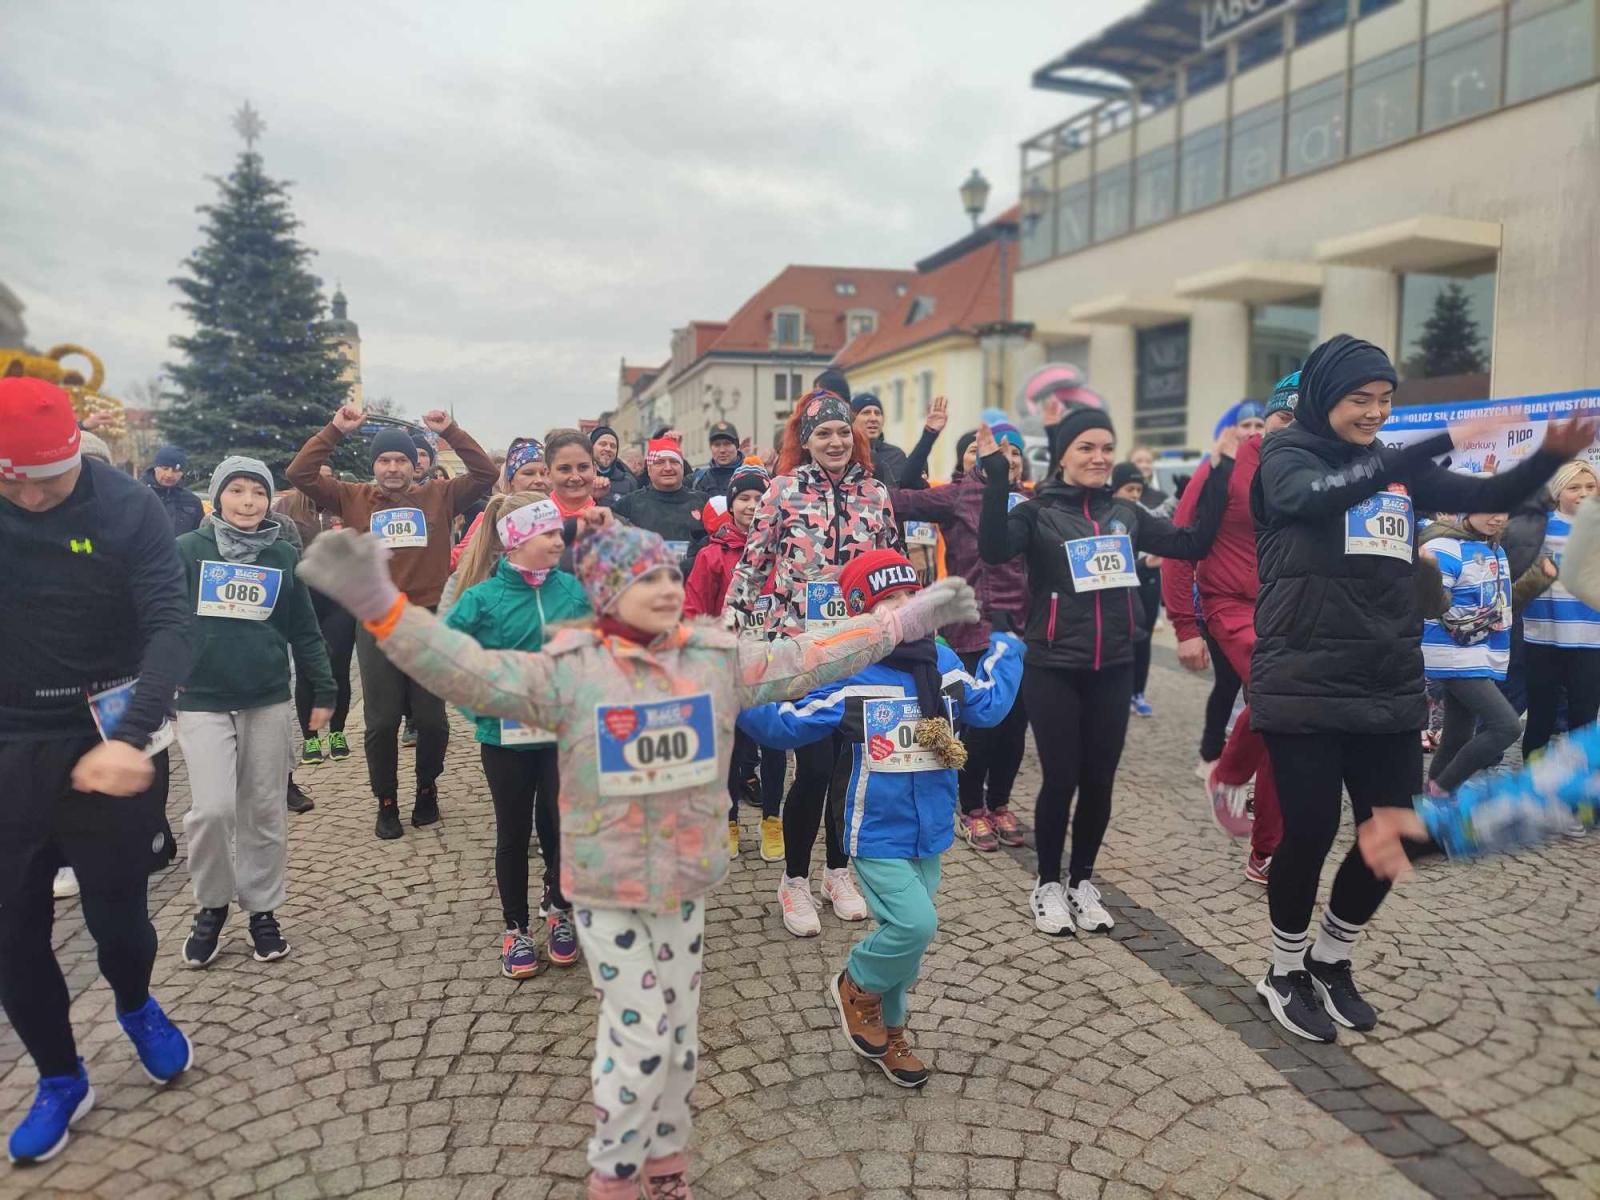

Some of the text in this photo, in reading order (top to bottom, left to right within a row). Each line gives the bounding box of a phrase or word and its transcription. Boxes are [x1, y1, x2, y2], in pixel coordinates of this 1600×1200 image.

[1524, 396, 1600, 415] BIAŁYMSTOK
[387, 522, 412, 536] 084
[1376, 516, 1405, 538] 130
[1094, 554, 1121, 572] 125
[868, 565, 917, 592] WILD
[224, 583, 260, 602] 086
[827, 600, 848, 617] 03
[749, 611, 767, 627] 06
[636, 731, 688, 765] 040
